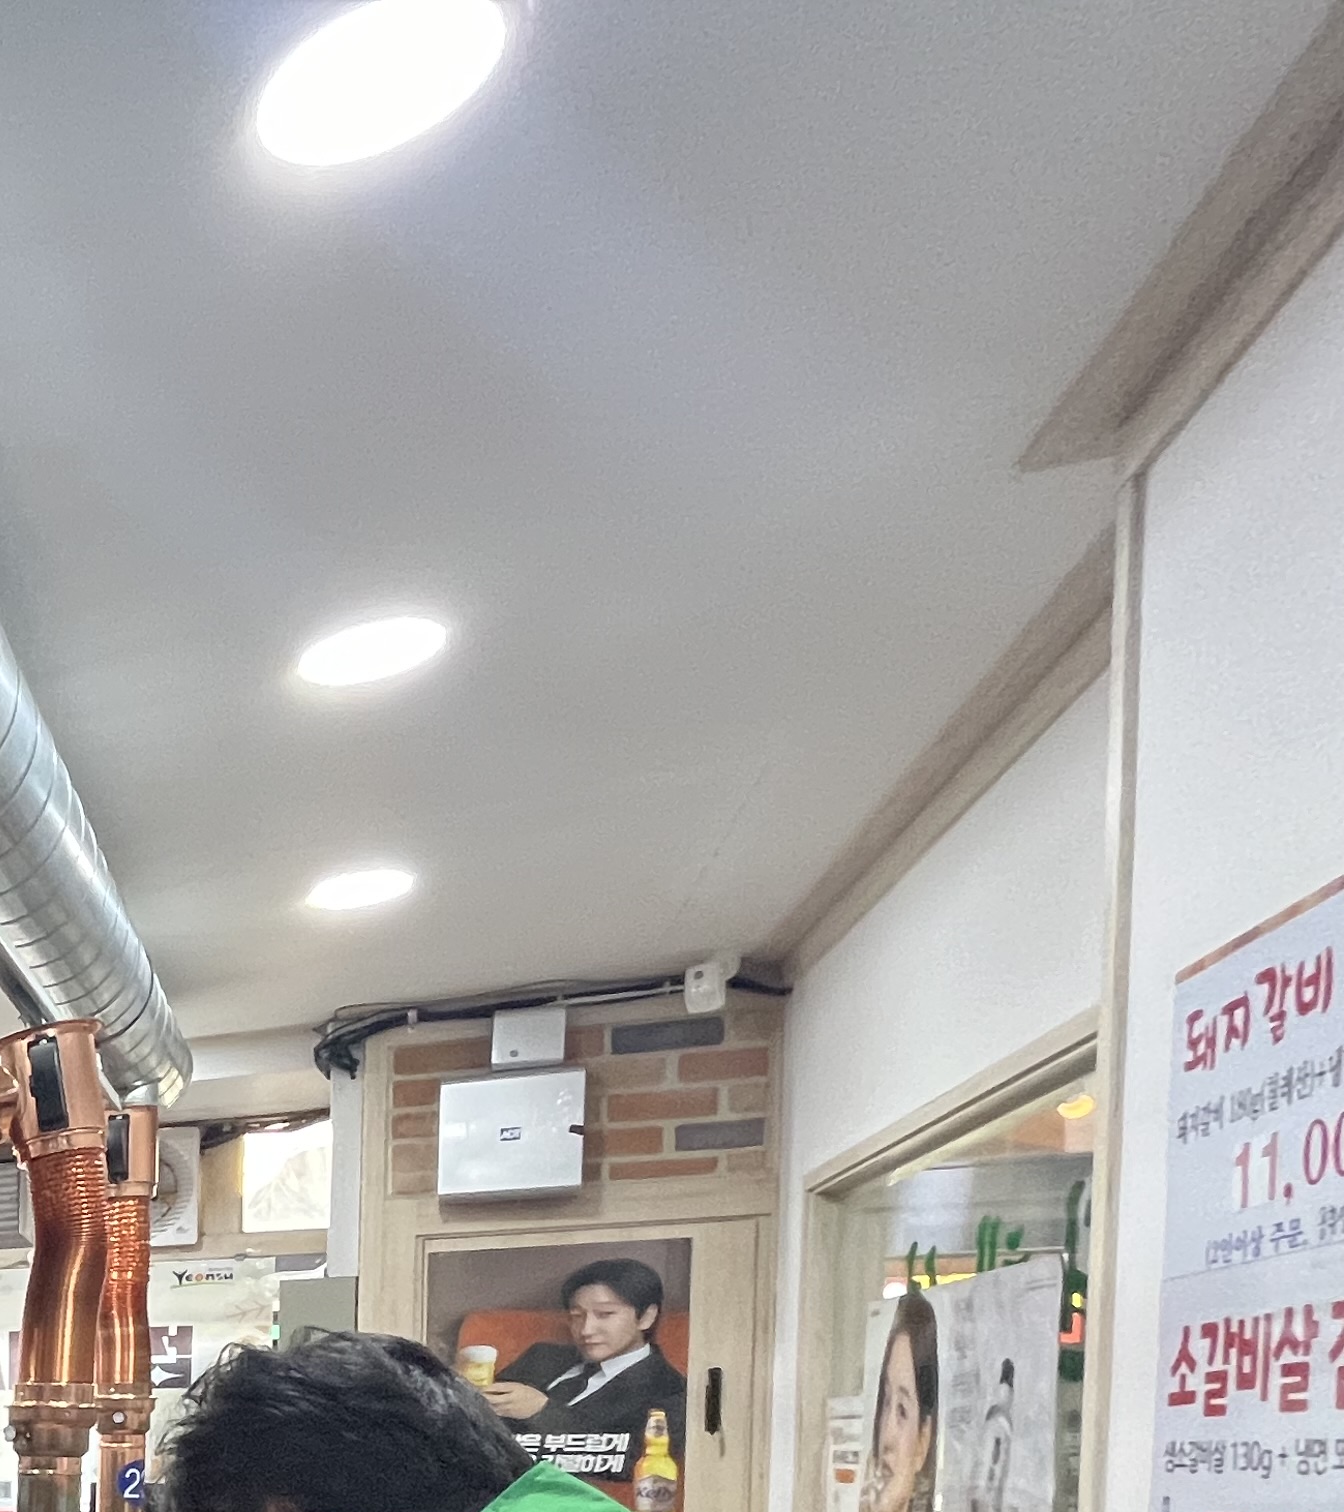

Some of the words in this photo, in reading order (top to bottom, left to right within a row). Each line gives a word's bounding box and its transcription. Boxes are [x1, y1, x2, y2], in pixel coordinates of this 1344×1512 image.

[1184, 945, 1334, 1073] 돼지갈비
[1167, 1303, 1320, 1417] 소갈비살
[543, 1432, 631, 1453] 부드럽게
